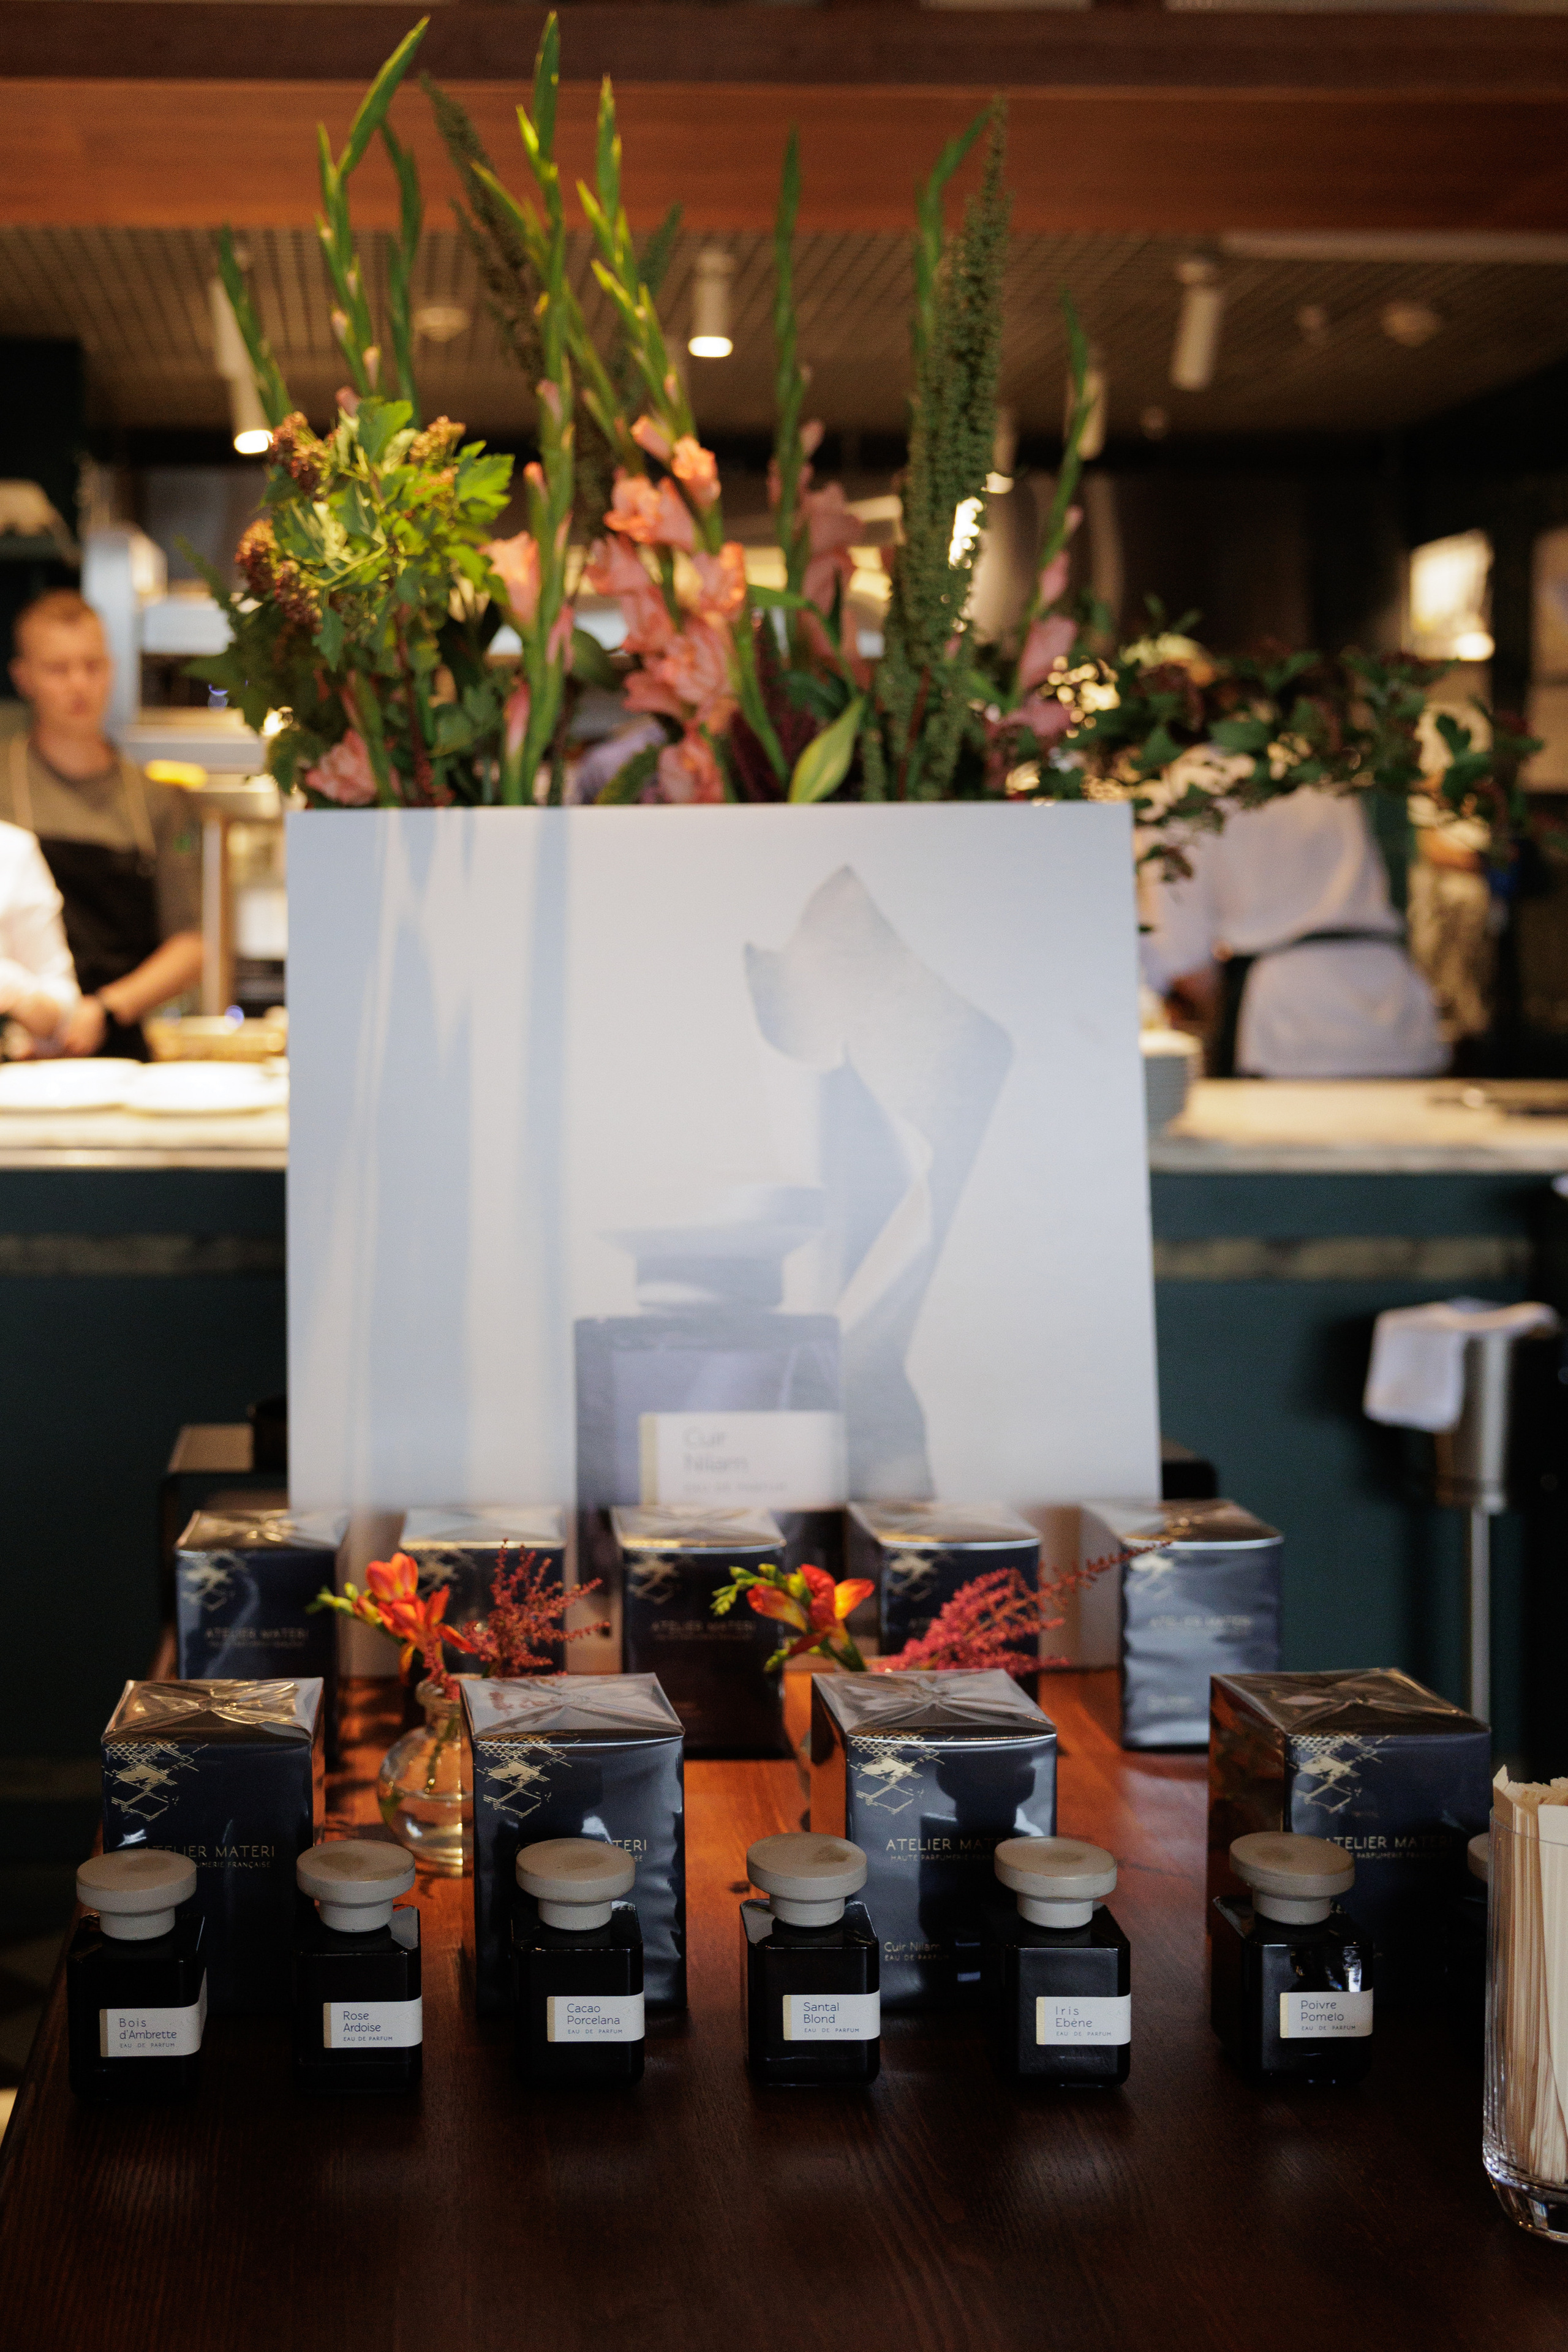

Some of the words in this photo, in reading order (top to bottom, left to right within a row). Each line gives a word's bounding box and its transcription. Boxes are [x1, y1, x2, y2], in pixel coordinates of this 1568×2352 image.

[604, 1839, 647, 1852] TERI
[885, 1838, 952, 1851] ATELIER
[1325, 1836, 1387, 1850] TELIER
[214, 1845, 276, 1858] MATERI
[884, 1941, 905, 1953] Cuir
[567, 2003, 600, 2013] Cacao
[803, 2002, 840, 2011] Santal
[1301, 2000, 1336, 2010] Poivre
[343, 2011, 369, 2020] Rose
[1055, 2006, 1079, 2016] Iris
[1301, 2011, 1344, 2021] Pomelo
[119, 2018, 146, 2027] Bois
[567, 2015, 620, 2025] Porcelana
[804, 2014, 835, 2024] Blond
[343, 2022, 381, 2032] Ardoise
